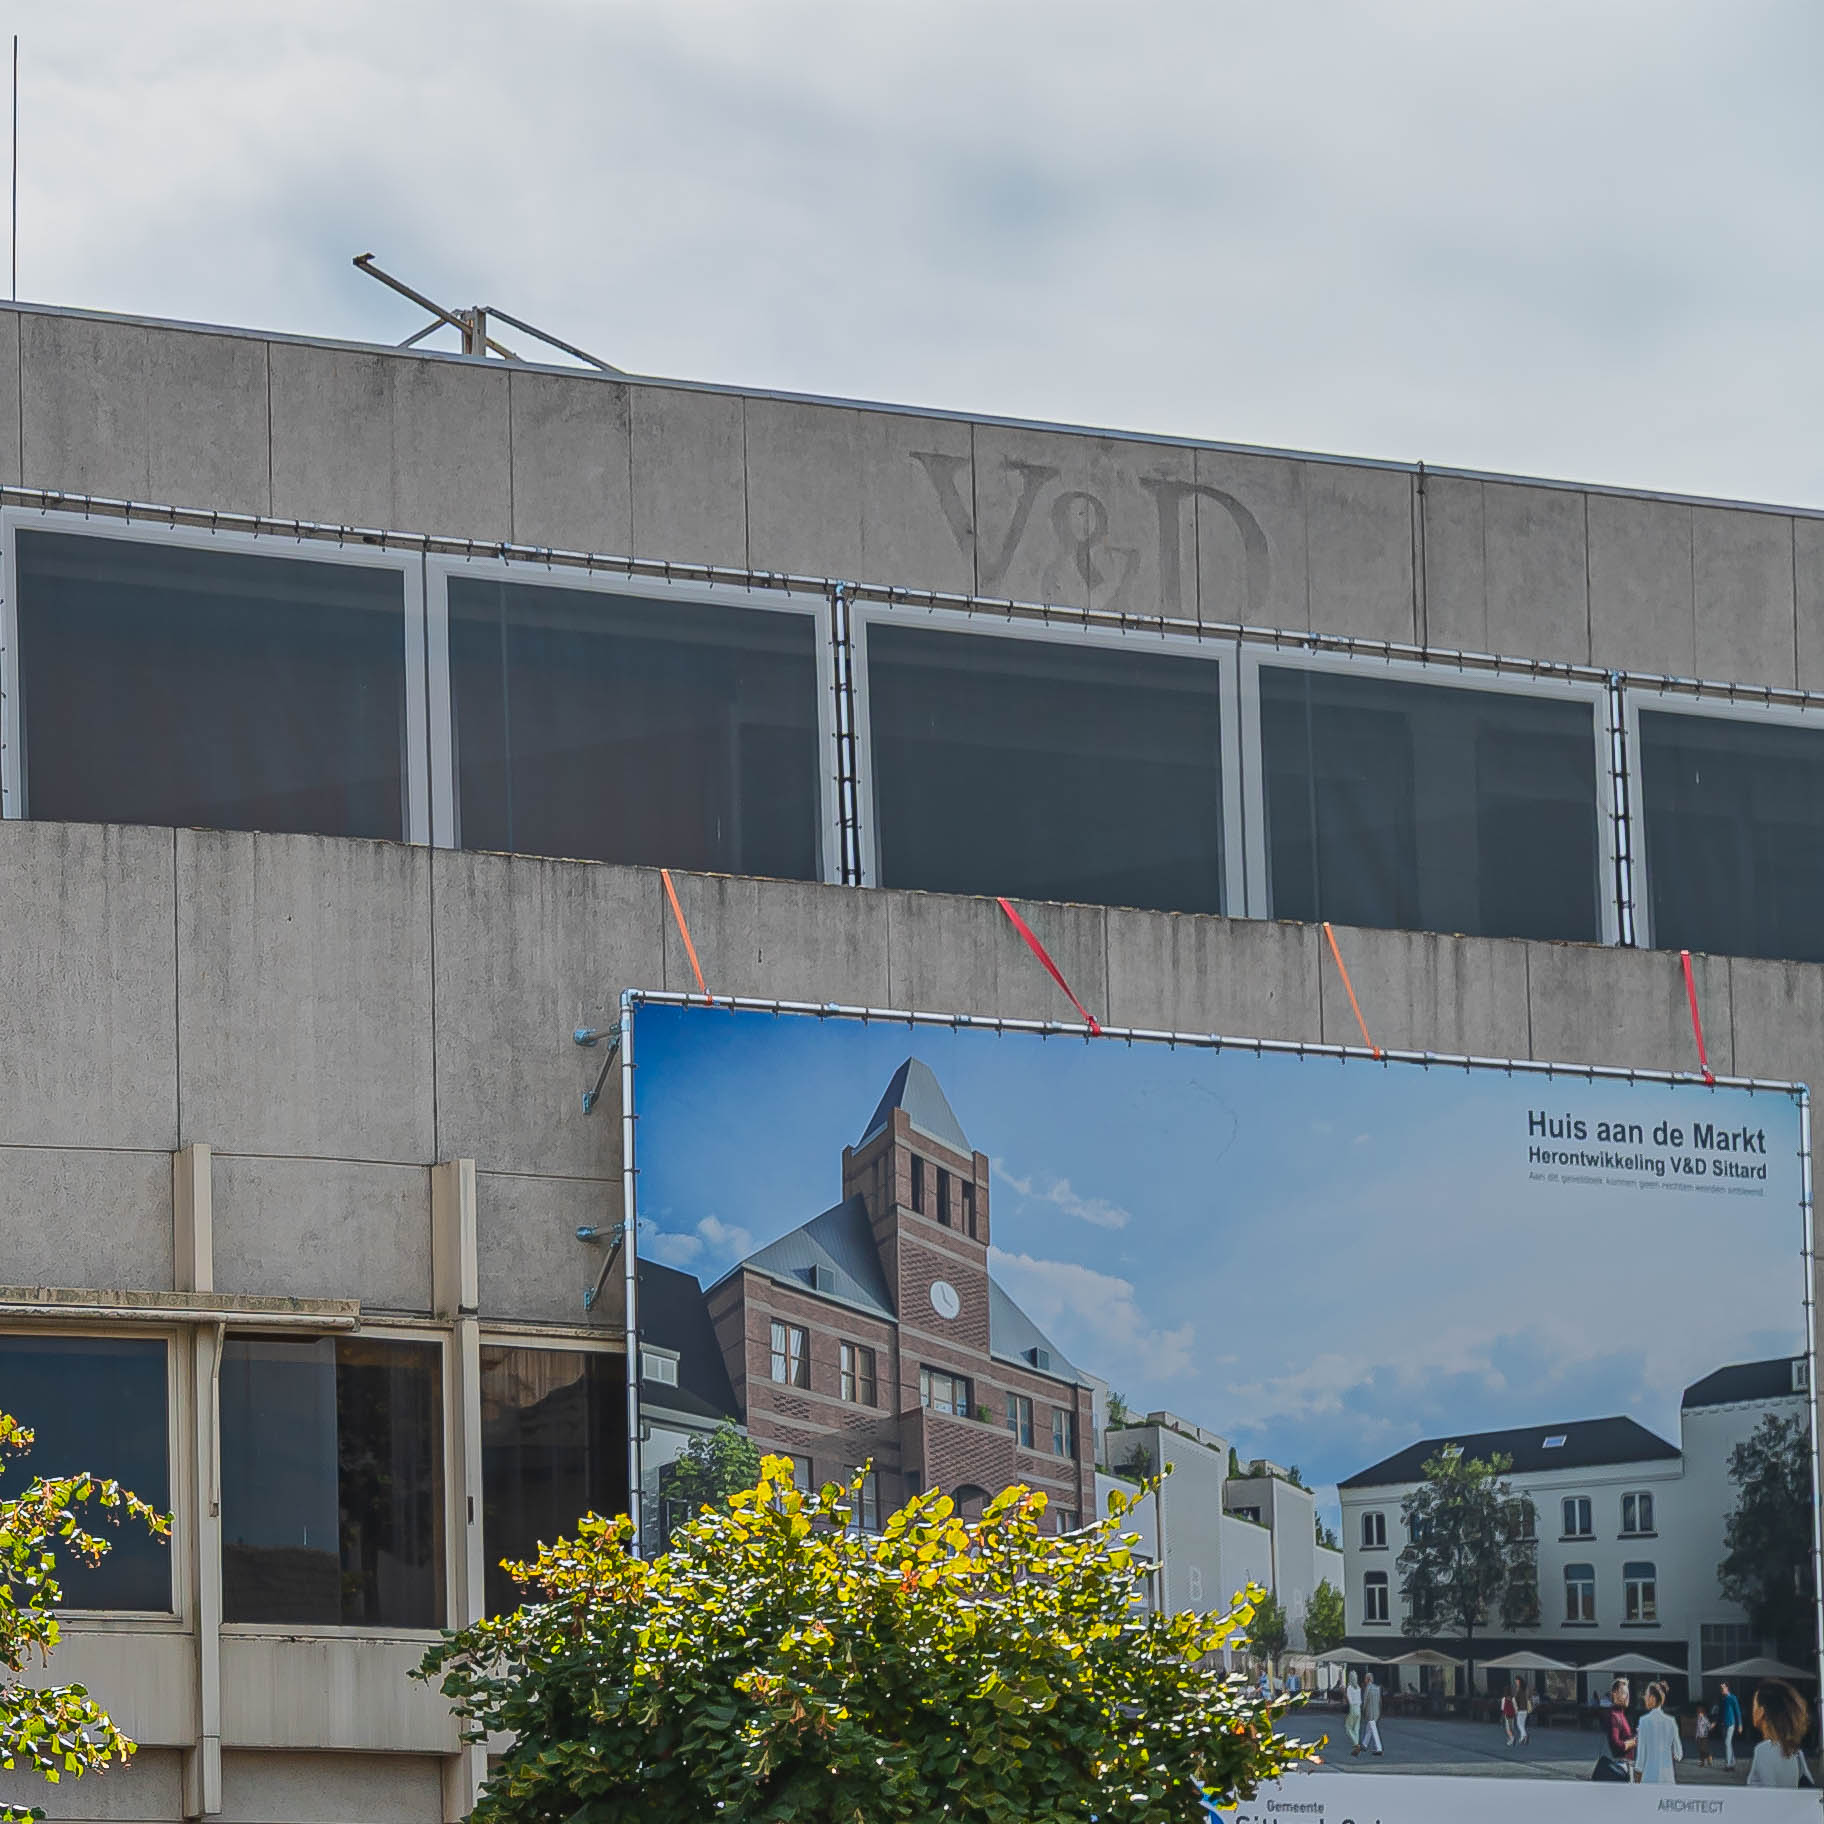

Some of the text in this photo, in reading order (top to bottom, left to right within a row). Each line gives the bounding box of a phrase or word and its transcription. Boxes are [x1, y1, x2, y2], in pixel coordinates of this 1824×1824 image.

[1527, 1110, 1767, 1155] Huis aan de Markt
[1527, 1145, 1767, 1180] Herontwikkeling V&D Sittard
[1266, 1799, 1325, 1814] Gemeente
[1657, 1798, 1725, 1814] ARCHITECT
